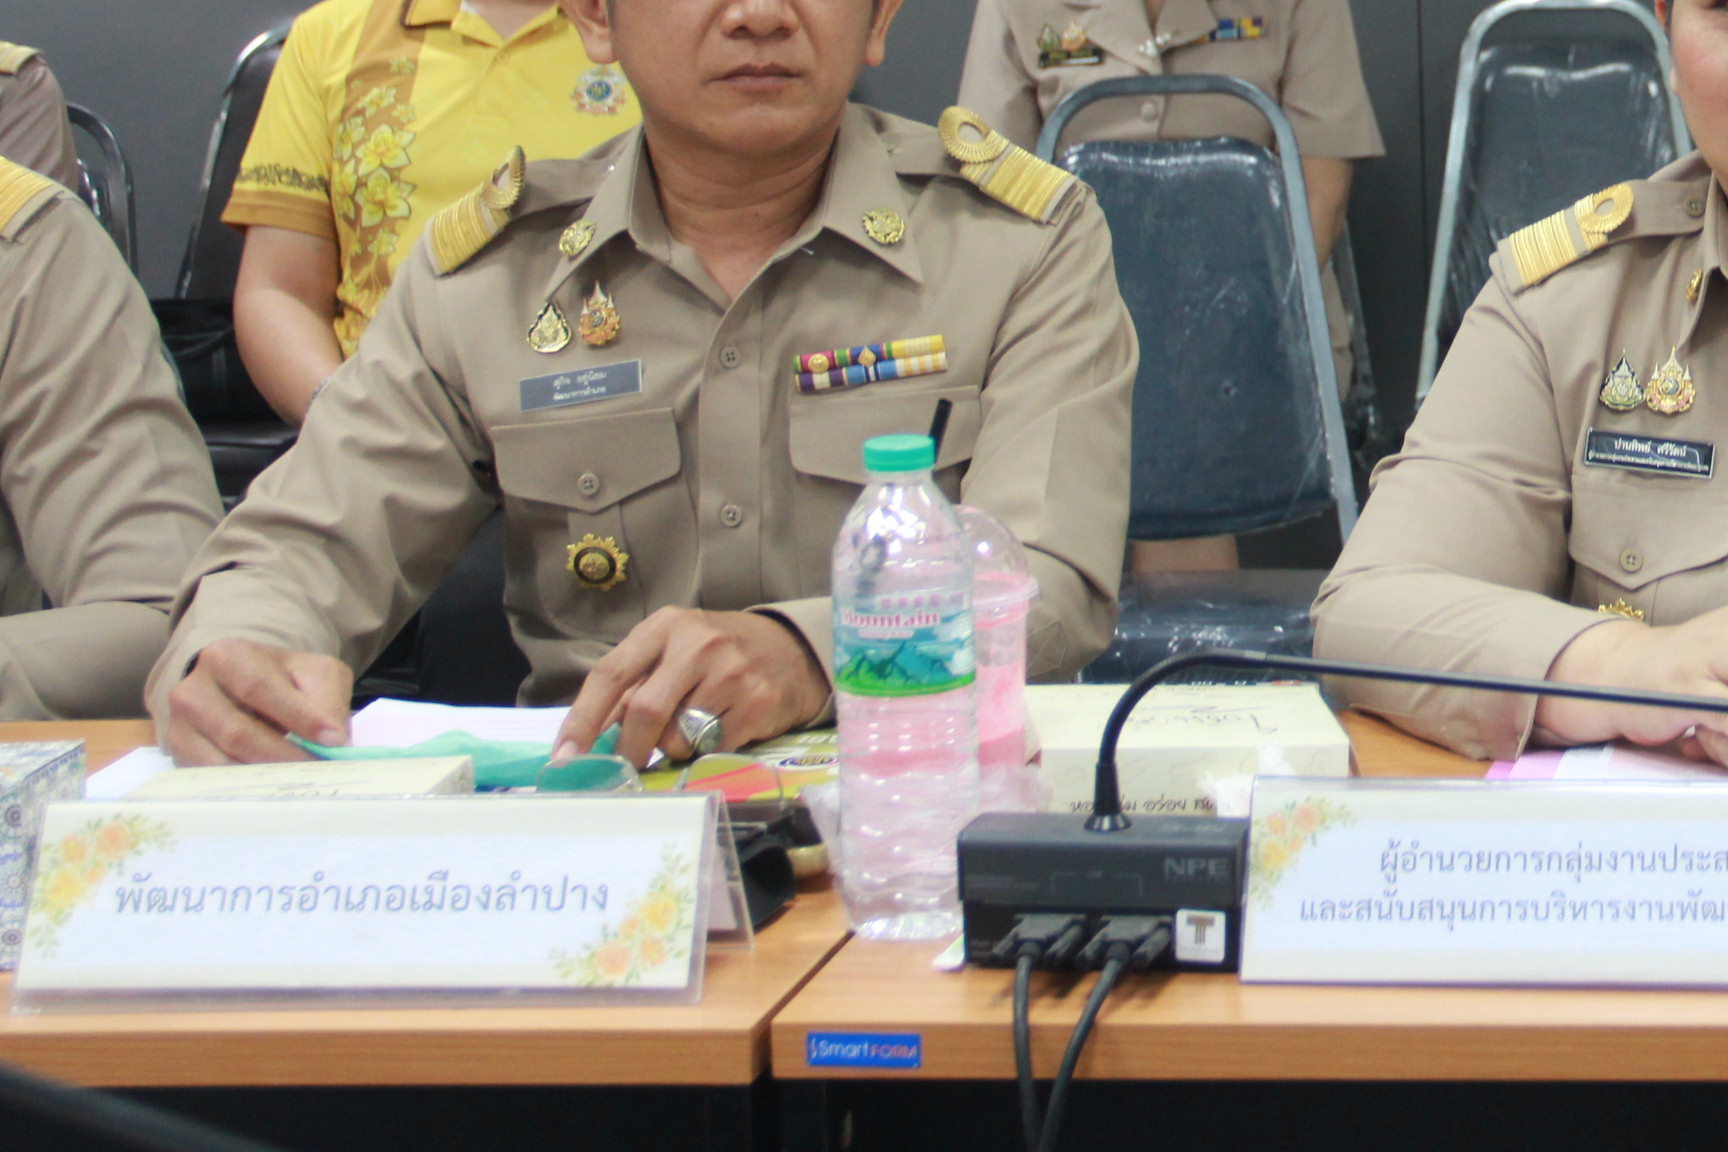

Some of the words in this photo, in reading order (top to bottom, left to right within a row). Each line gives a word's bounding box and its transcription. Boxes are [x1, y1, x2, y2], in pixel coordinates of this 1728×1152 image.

[115, 868, 609, 915] พัฒนาการอำเภอเมืองลำปาง
